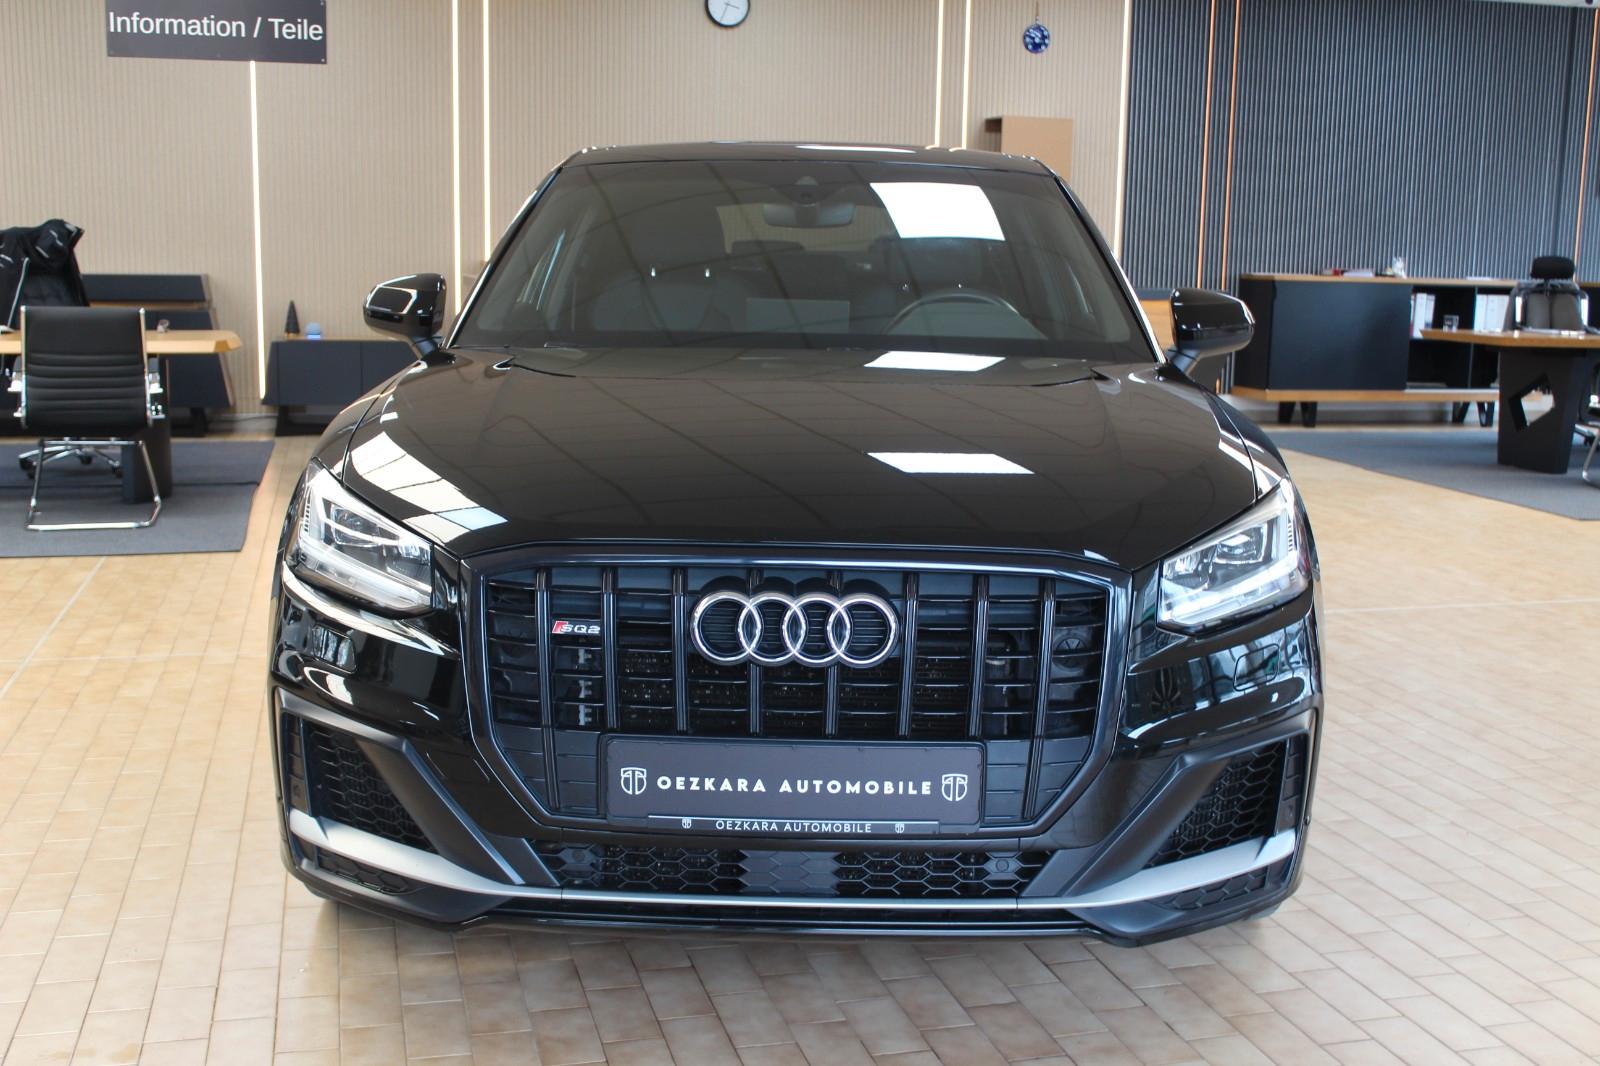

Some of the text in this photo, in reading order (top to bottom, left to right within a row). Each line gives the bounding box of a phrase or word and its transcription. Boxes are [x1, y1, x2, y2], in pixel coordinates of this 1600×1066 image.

[108, 11, 246, 38] Information
[268, 18, 324, 41] Teile
[559, 623, 600, 634] SQ2
[656, 775, 932, 795] OEZKARA AUTOMOBILE
[715, 819, 872, 833] OEZKARA AUTOMOBILE
